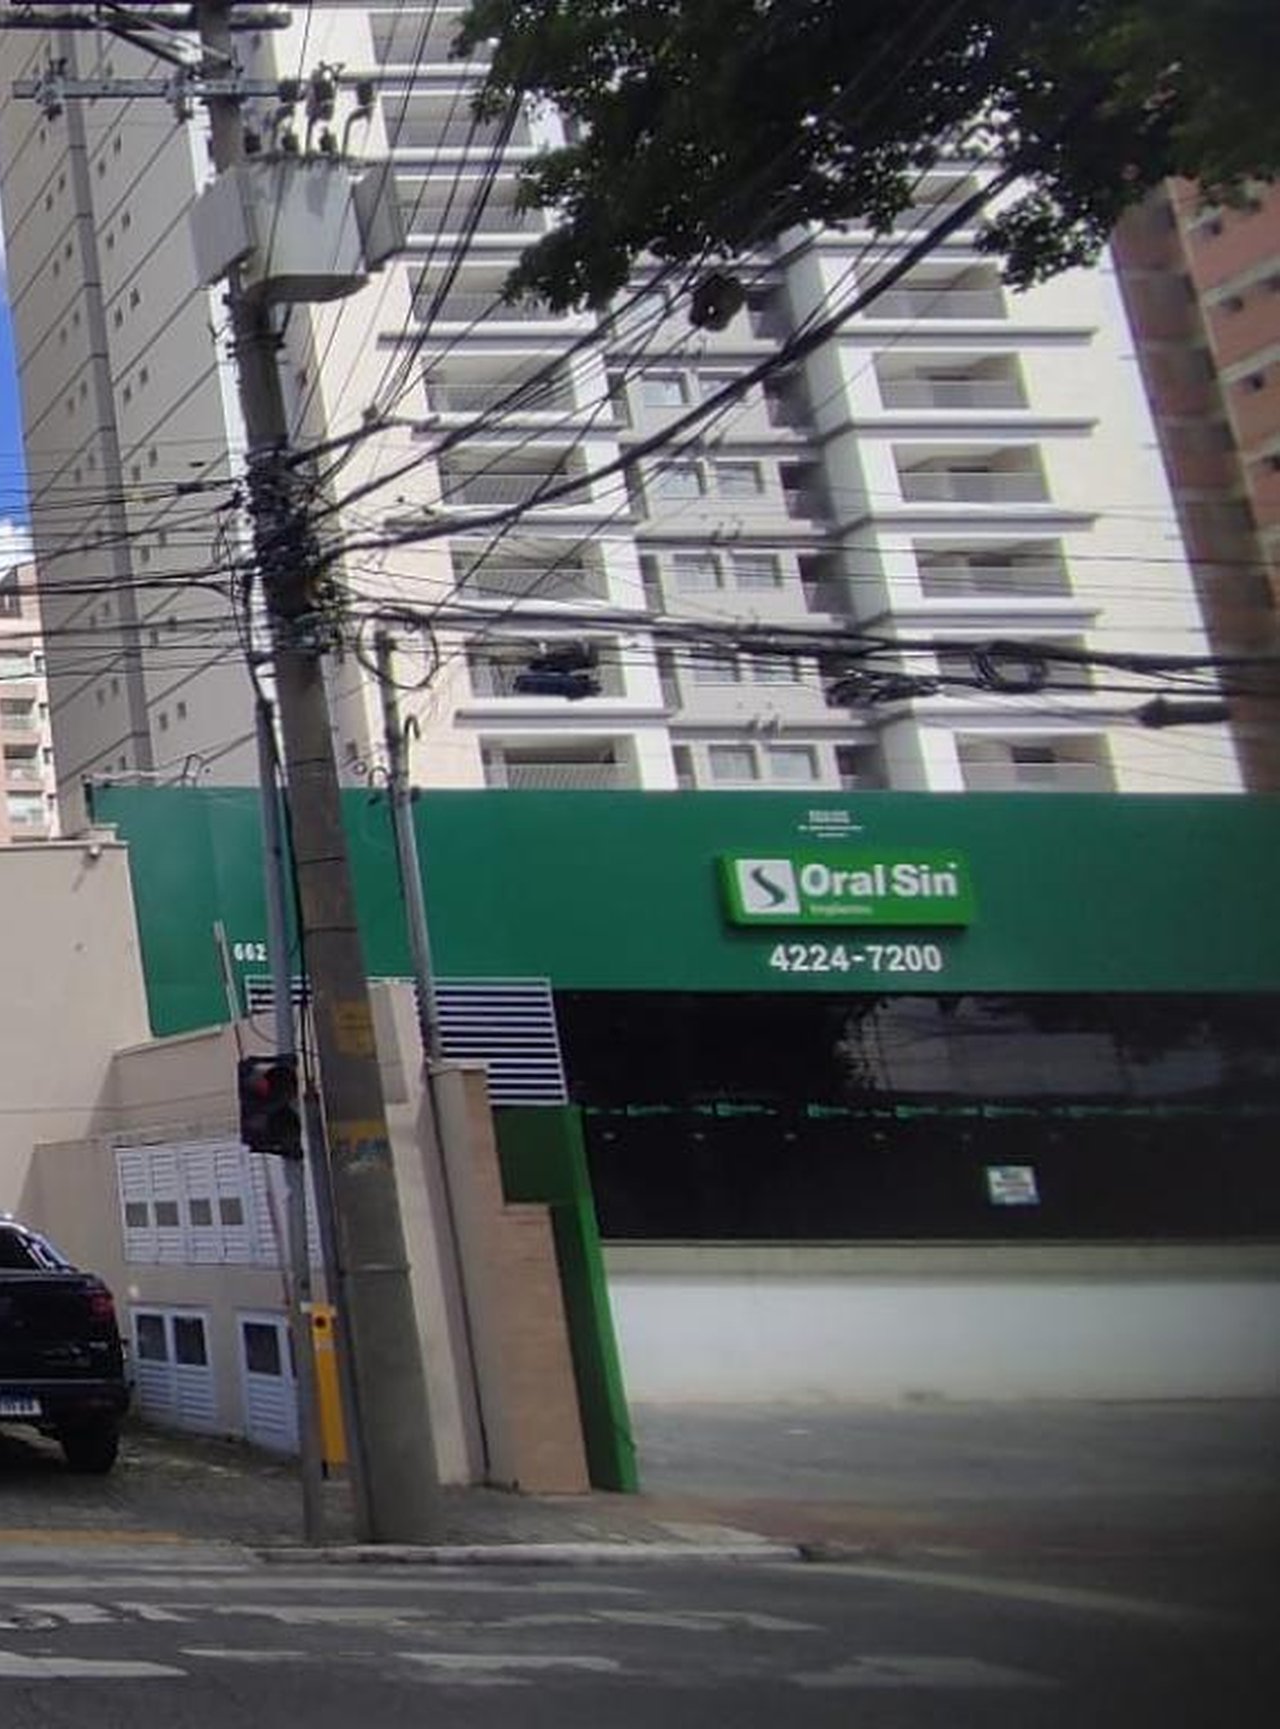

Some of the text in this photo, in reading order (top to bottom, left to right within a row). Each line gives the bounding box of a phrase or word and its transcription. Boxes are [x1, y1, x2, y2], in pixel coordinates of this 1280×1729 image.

[800, 863, 958, 897] Oral Sin
[233, 943, 268, 961] 662
[769, 944, 943, 972] 4224-7200
